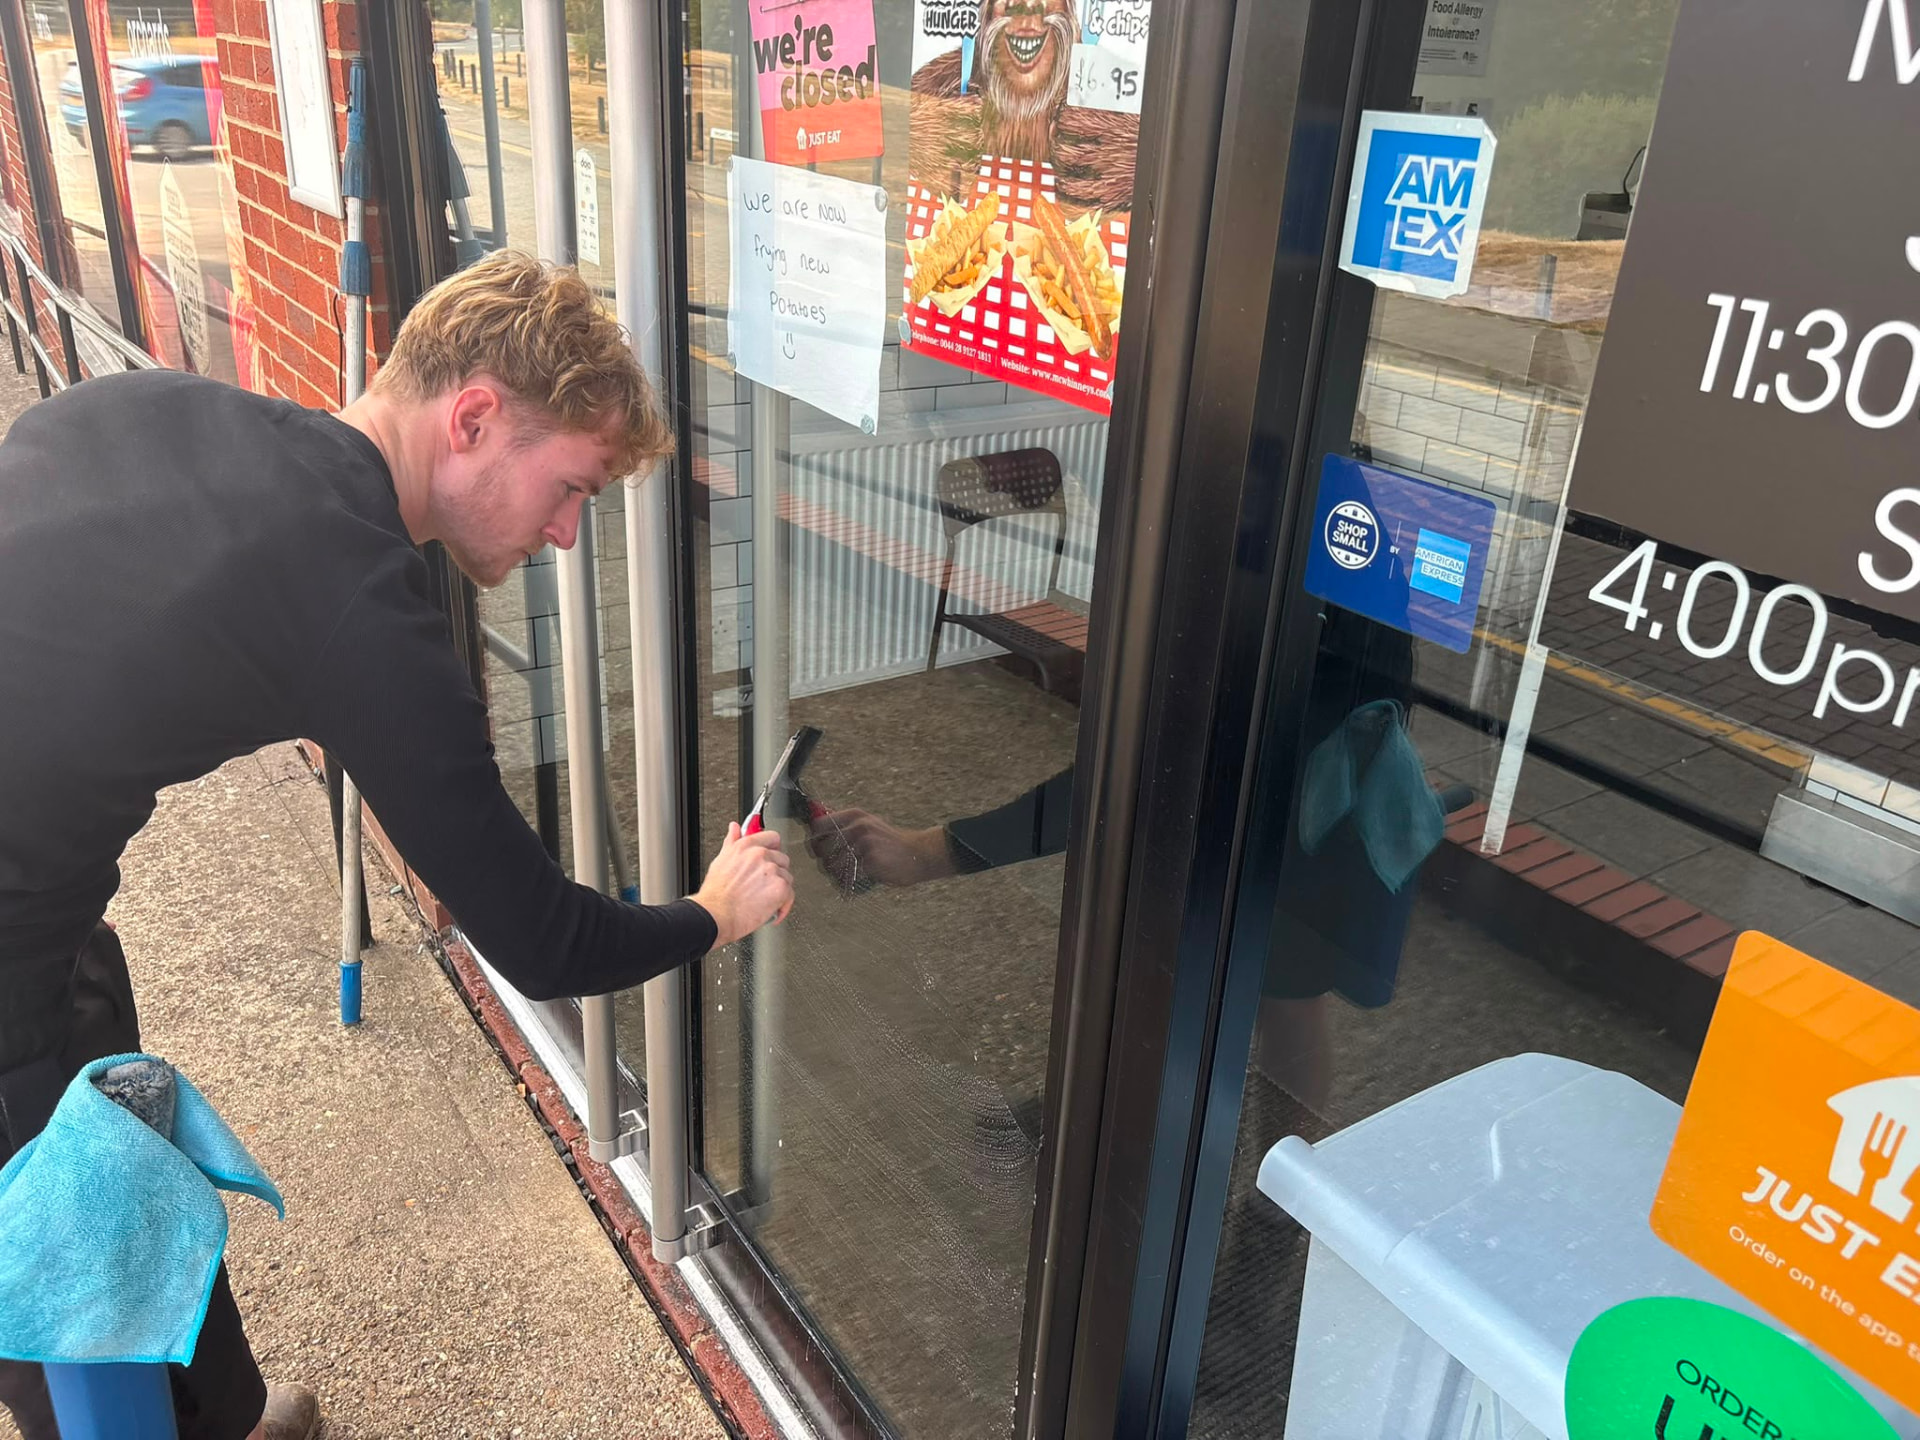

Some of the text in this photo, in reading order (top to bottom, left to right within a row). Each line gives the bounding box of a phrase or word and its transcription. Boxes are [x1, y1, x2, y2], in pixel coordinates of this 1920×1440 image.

[925, 9, 977, 31] HUNGER
[1432, 1, 1484, 19] Food Allergy
[1088, 8, 1150, 43] & chips
[1428, 25, 1480, 40] Intolerance?
[754, 15, 833, 74] we're
[781, 45, 876, 112] closed
[809, 130, 842, 147] JUST EAT
[783, 200, 808, 219] are
[755, 234, 830, 276] frying new
[955, 343, 962, 353] 28
[1000, 357, 1031, 375] Website:
[1700, 293, 1920, 429] 11:30
[1332, 530, 1368, 553] SMALL
[1337, 520, 1368, 539] SHOP
[1390, 545, 1400, 555] BY
[1415, 548, 1464, 572] AMERICAN
[1421, 563, 1464, 587] EXPRESS
[1588, 540, 1920, 727] 4:00p
[1741, 1165, 1920, 1306] JUST E
[1729, 1226, 1785, 1268] Order
[1789, 1267, 1816, 1290] on
[1820, 1284, 1855, 1316] the
[1858, 1313, 1904, 1347] app
[1676, 1359, 1782, 1440] ORDER
